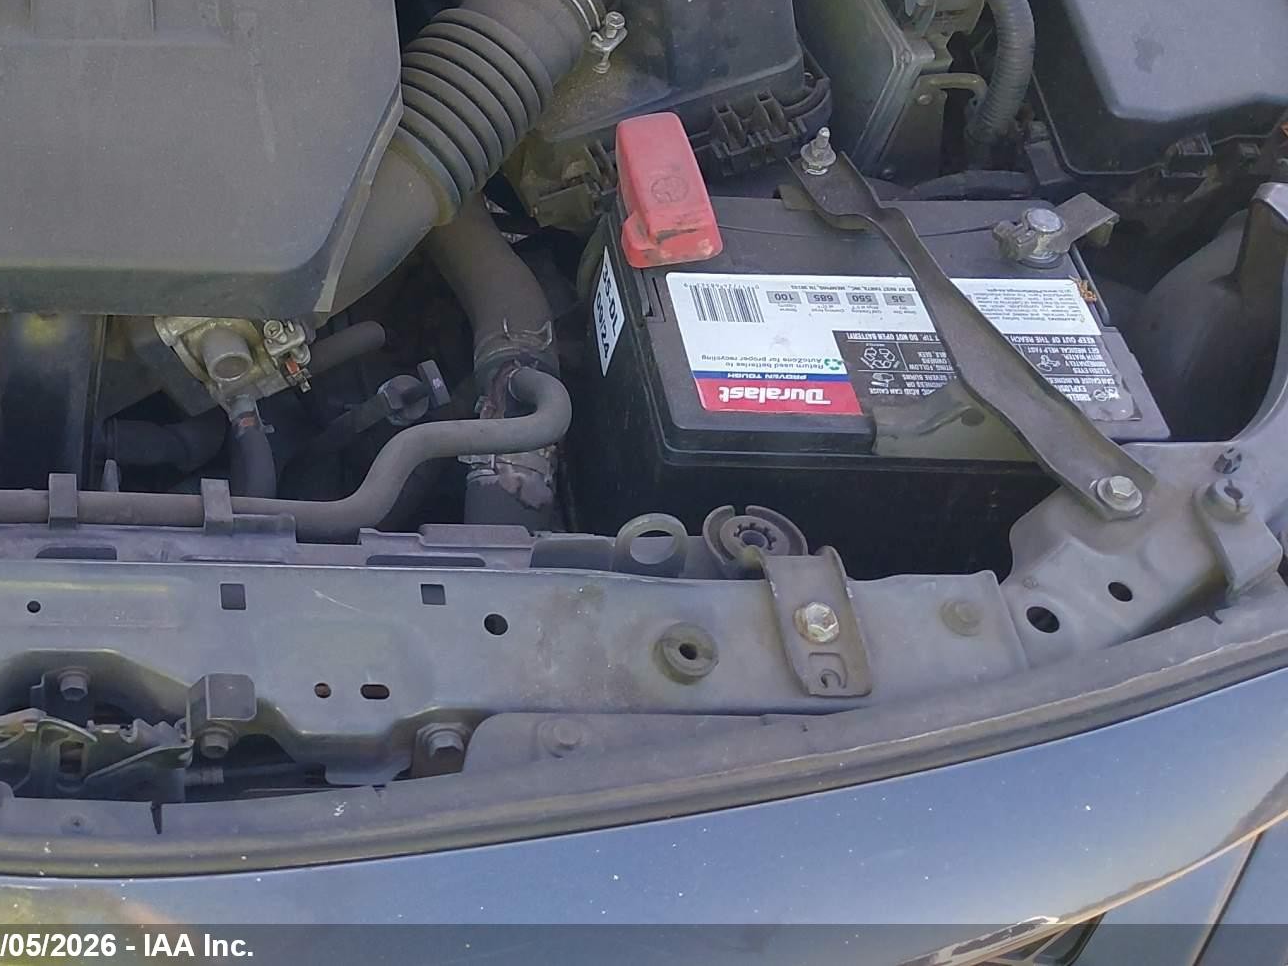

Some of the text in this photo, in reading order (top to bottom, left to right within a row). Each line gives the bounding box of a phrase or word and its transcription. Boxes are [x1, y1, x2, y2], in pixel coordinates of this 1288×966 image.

[602, 265, 618, 337] 35-DL
[596, 292, 610, 358] 09/24
[739, 355, 766, 363] proper
[718, 386, 832, 405] Duralast
